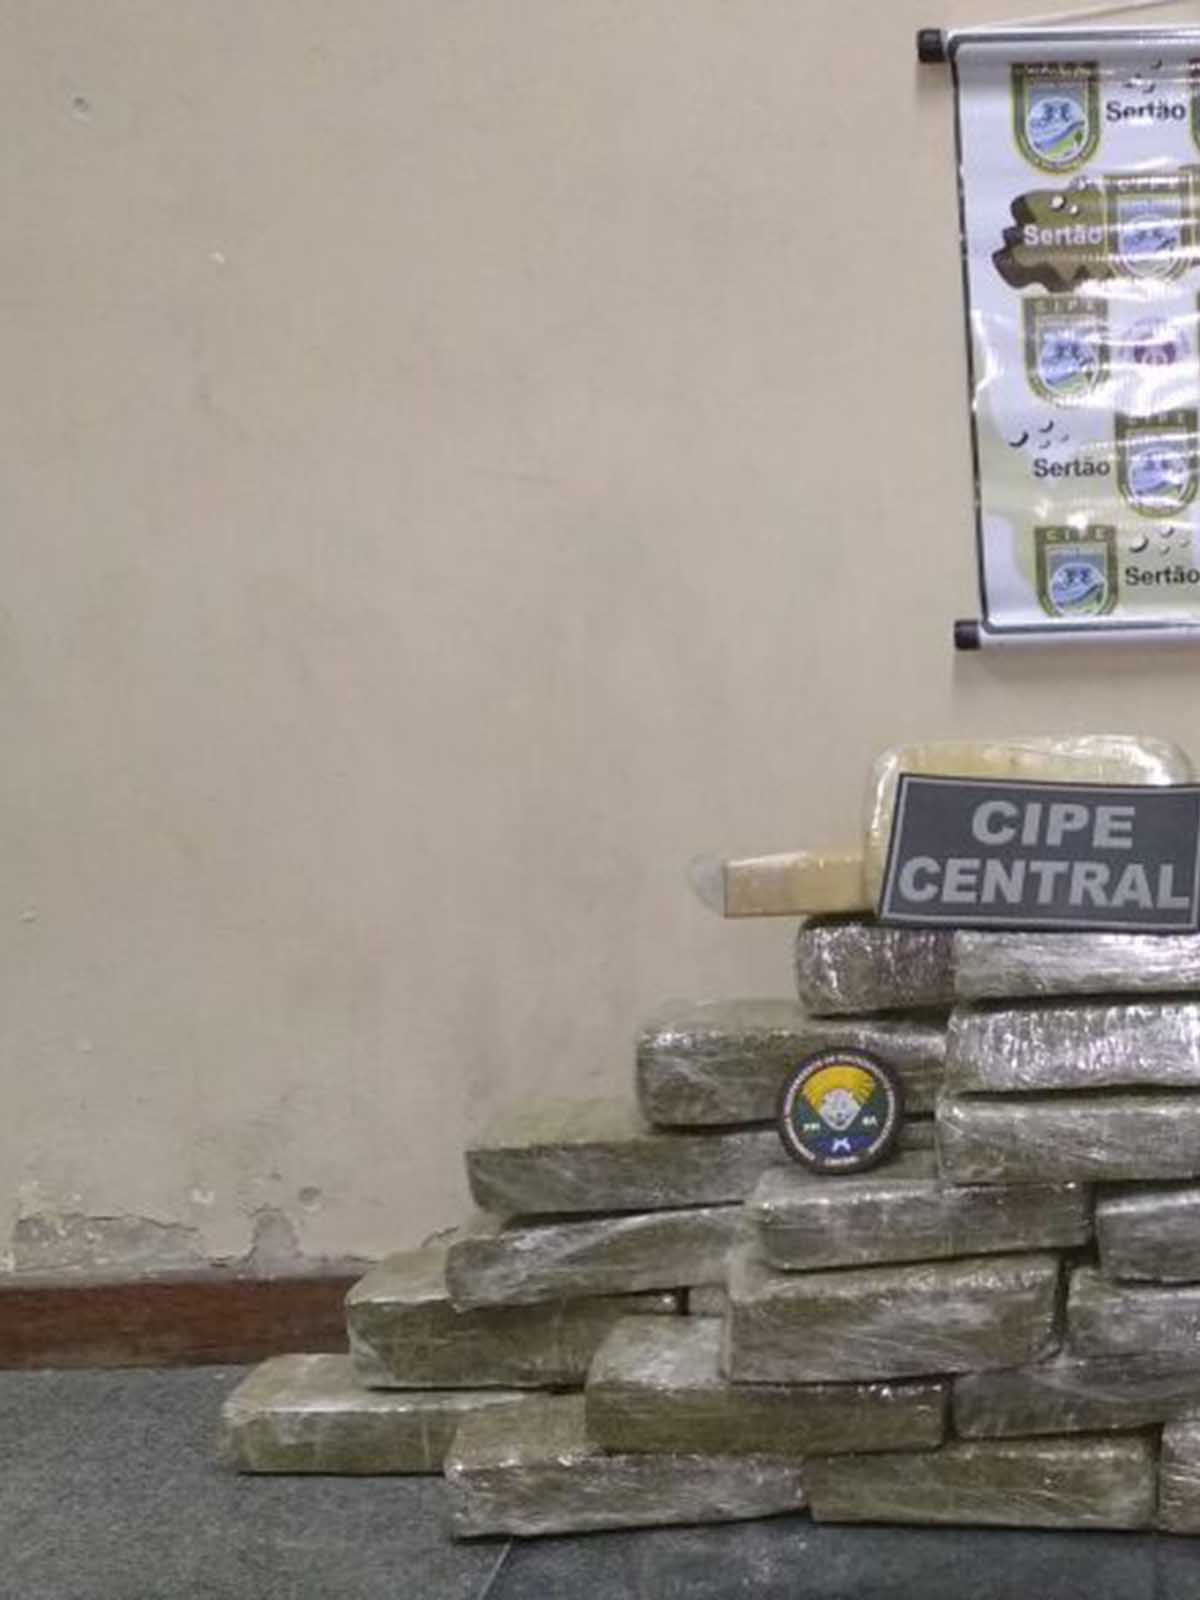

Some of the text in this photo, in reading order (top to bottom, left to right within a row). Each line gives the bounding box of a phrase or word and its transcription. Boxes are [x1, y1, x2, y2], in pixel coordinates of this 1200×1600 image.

[1106, 98, 1186, 122] Sertão
[1022, 224, 1104, 246] Sertão
[1033, 457, 1110, 478] Sertão
[1125, 565, 1200, 586] Sertão
[971, 799, 1136, 849] CIPE
[899, 855, 1191, 909] CENTRAL
